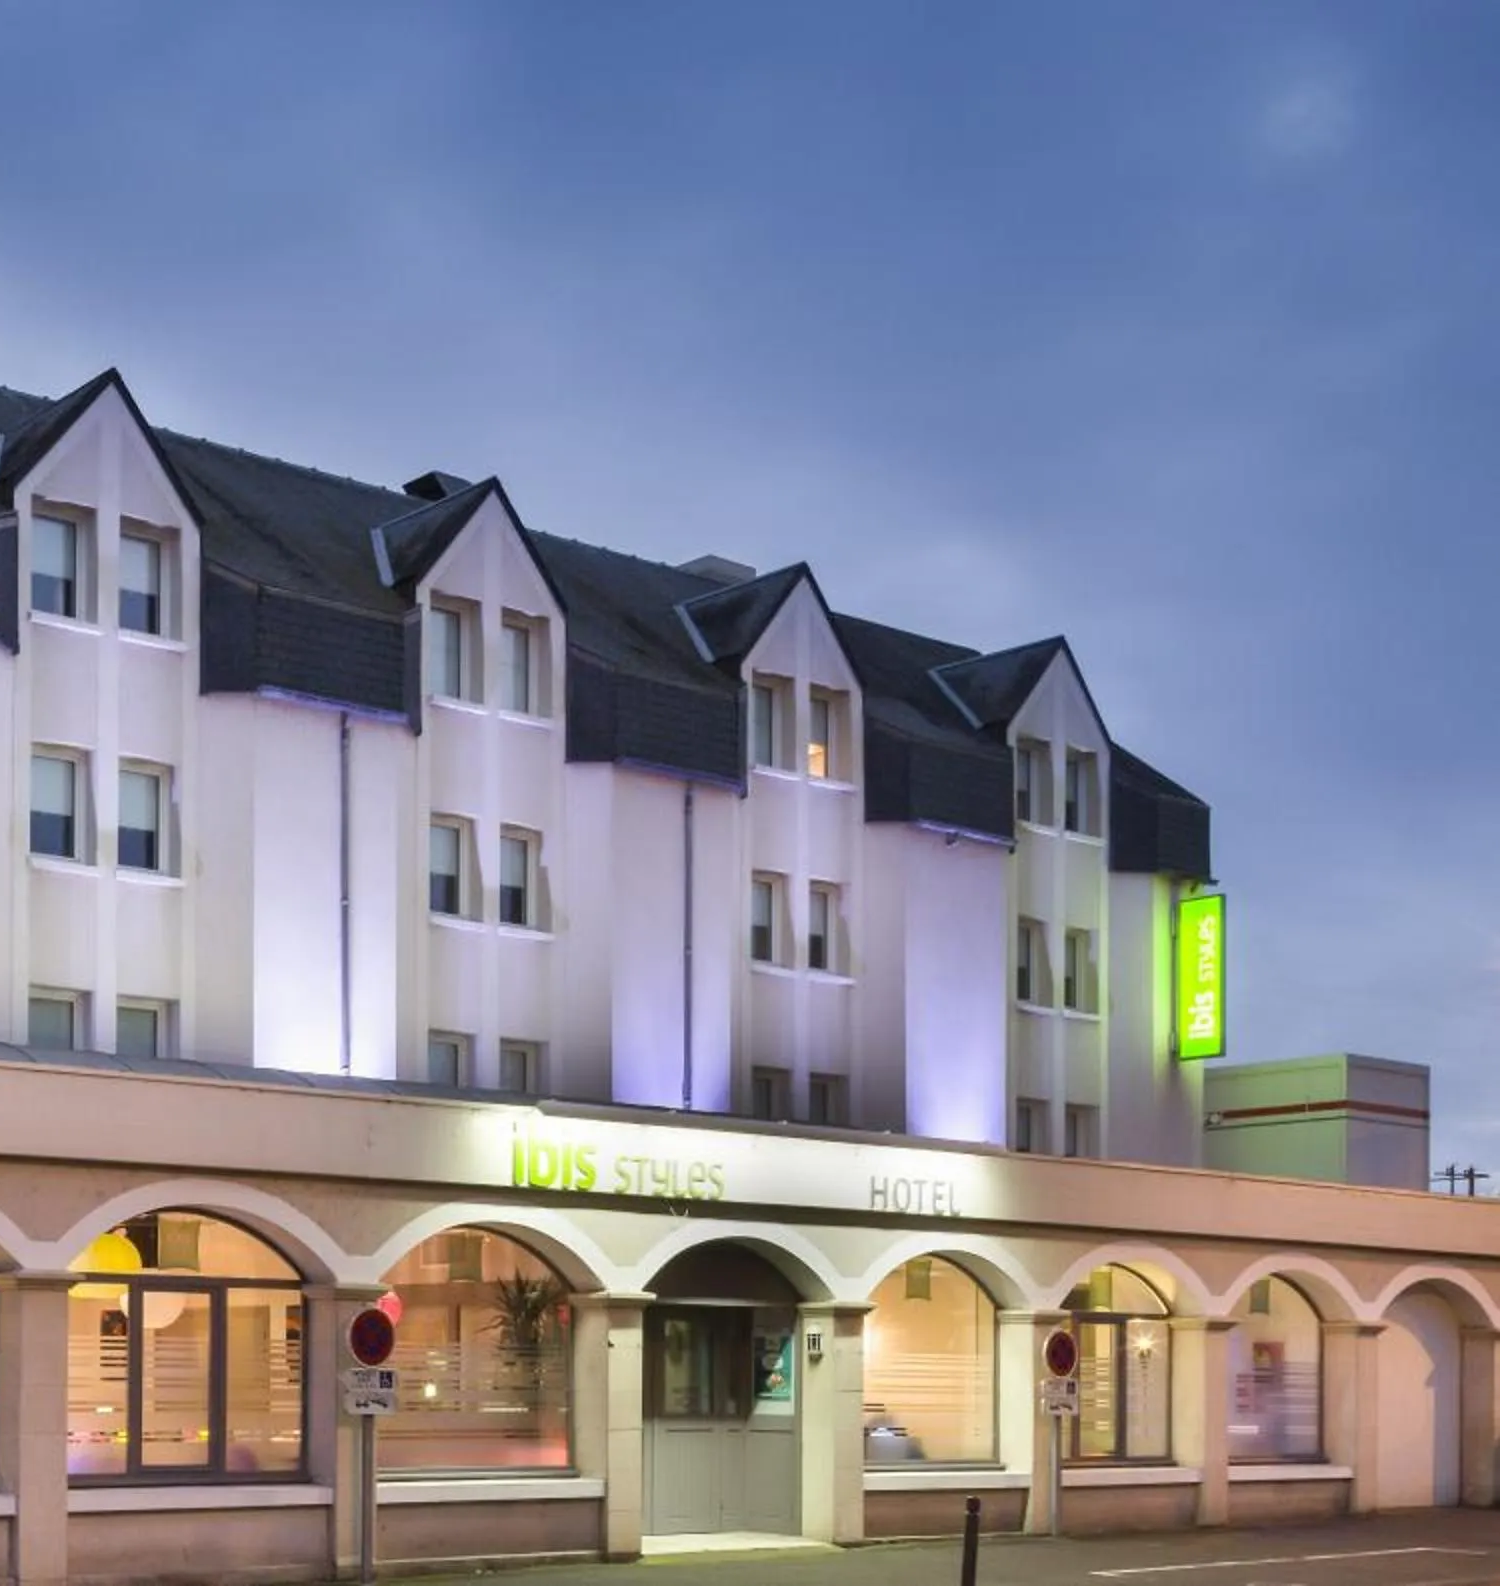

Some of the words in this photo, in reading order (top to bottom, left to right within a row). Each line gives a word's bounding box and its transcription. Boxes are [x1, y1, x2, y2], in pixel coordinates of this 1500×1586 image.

[1187, 990, 1215, 1040] ibis
[511, 1120, 598, 1193] ibis
[869, 1175, 962, 1217] HOTEL
